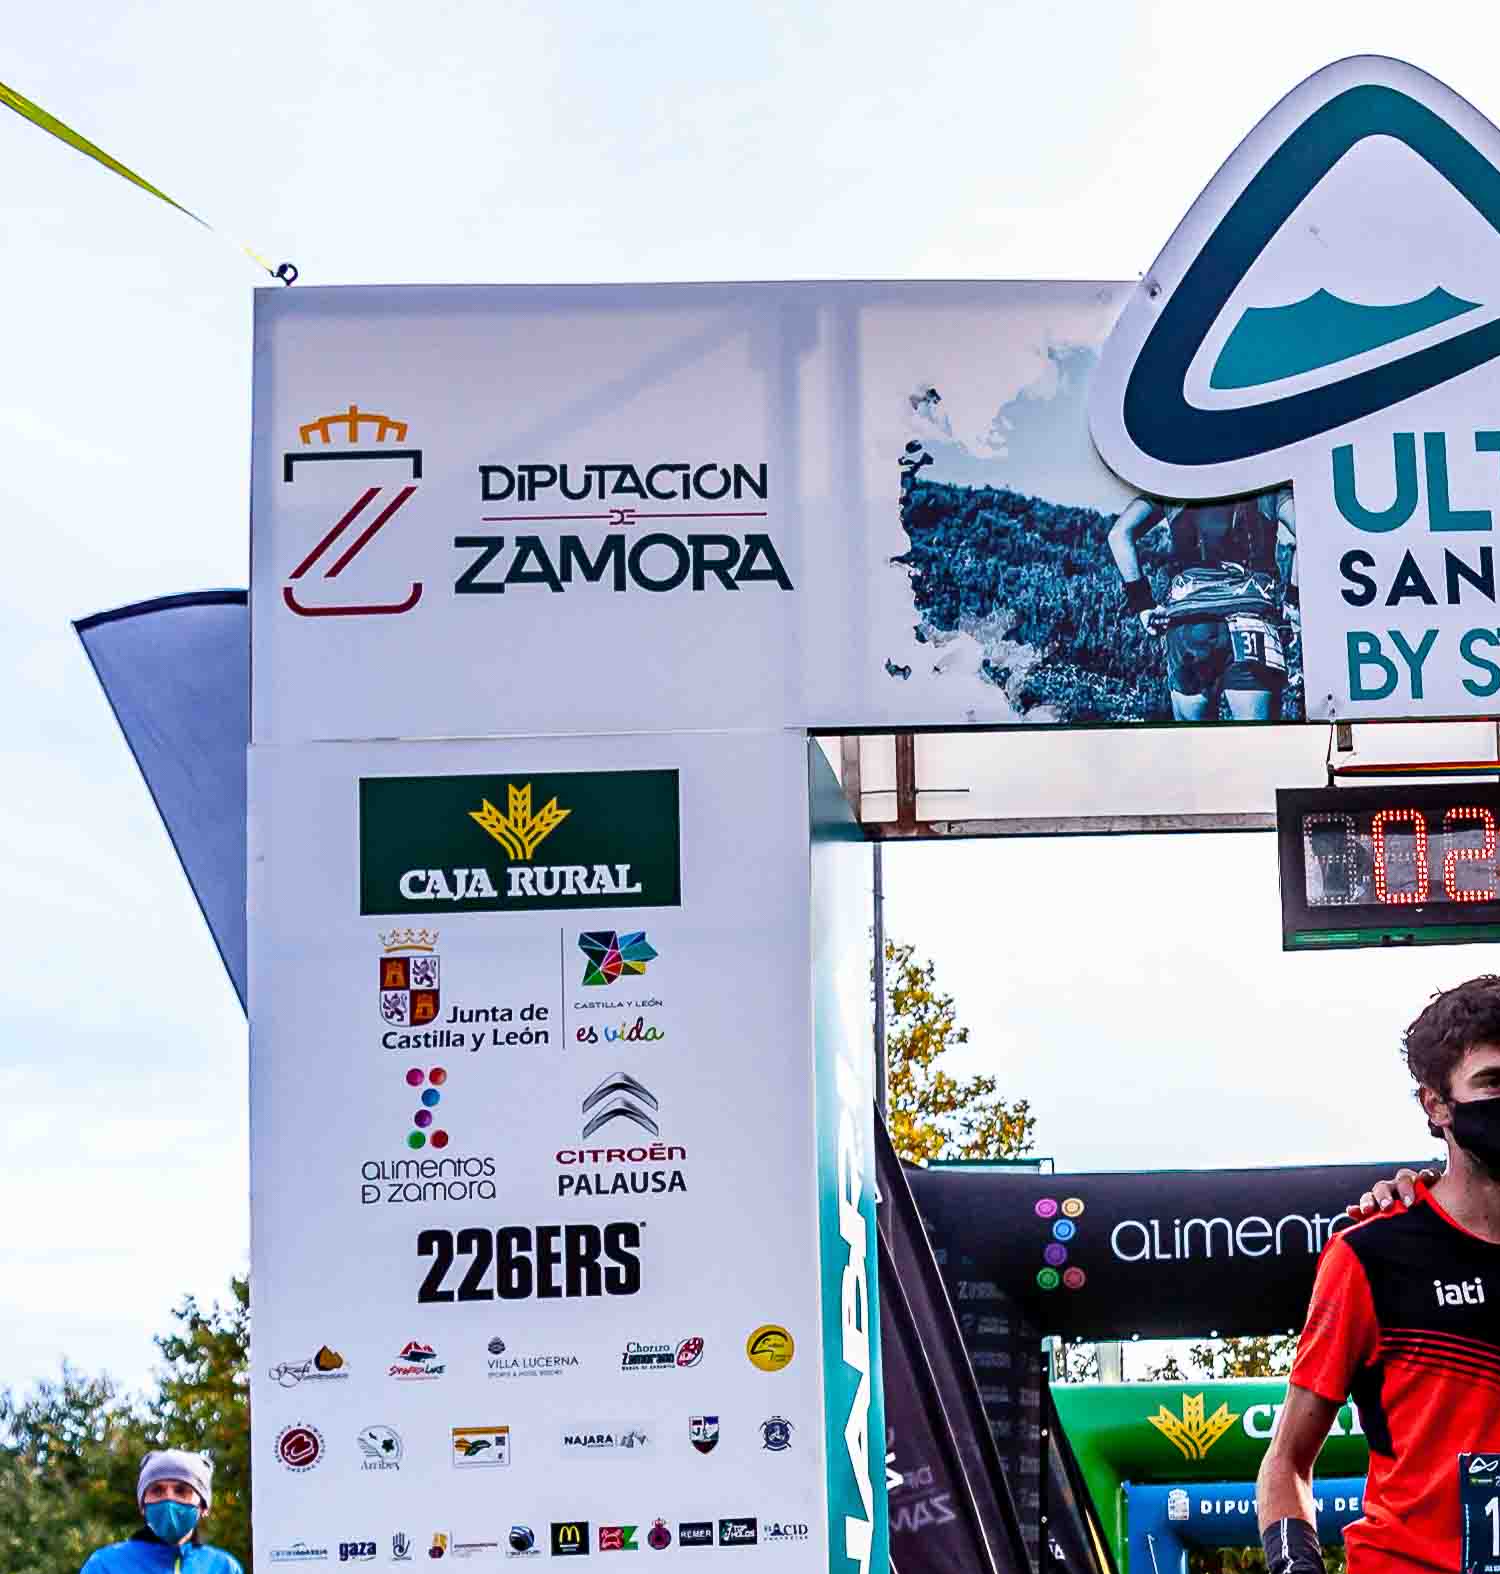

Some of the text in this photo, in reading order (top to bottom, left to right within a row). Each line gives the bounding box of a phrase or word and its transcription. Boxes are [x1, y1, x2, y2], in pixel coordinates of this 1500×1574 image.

[454, 533, 794, 594] ZAMORA
[1346, 628, 1439, 702] BY
[400, 864, 642, 901] CAJA RURAL
[446, 1003, 549, 1024] Junta de
[573, 1000, 625, 1010] CASTILLA
[382, 1027, 549, 1052] Castilla y León
[576, 1016, 665, 1044] es vida
[555, 1142, 687, 1165] CITROËN
[361, 1156, 496, 1181] alimentos
[387, 1179, 497, 1202] zamora
[557, 1170, 687, 1197] PALAUSA
[417, 1222, 642, 1304] 226ERS
[1433, 1277, 1485, 1306] iati
[487, 1356, 579, 1370] VILLA LUCERNA
[1334, 1496, 1359, 1512] DE
[339, 1541, 377, 1562] gaza
